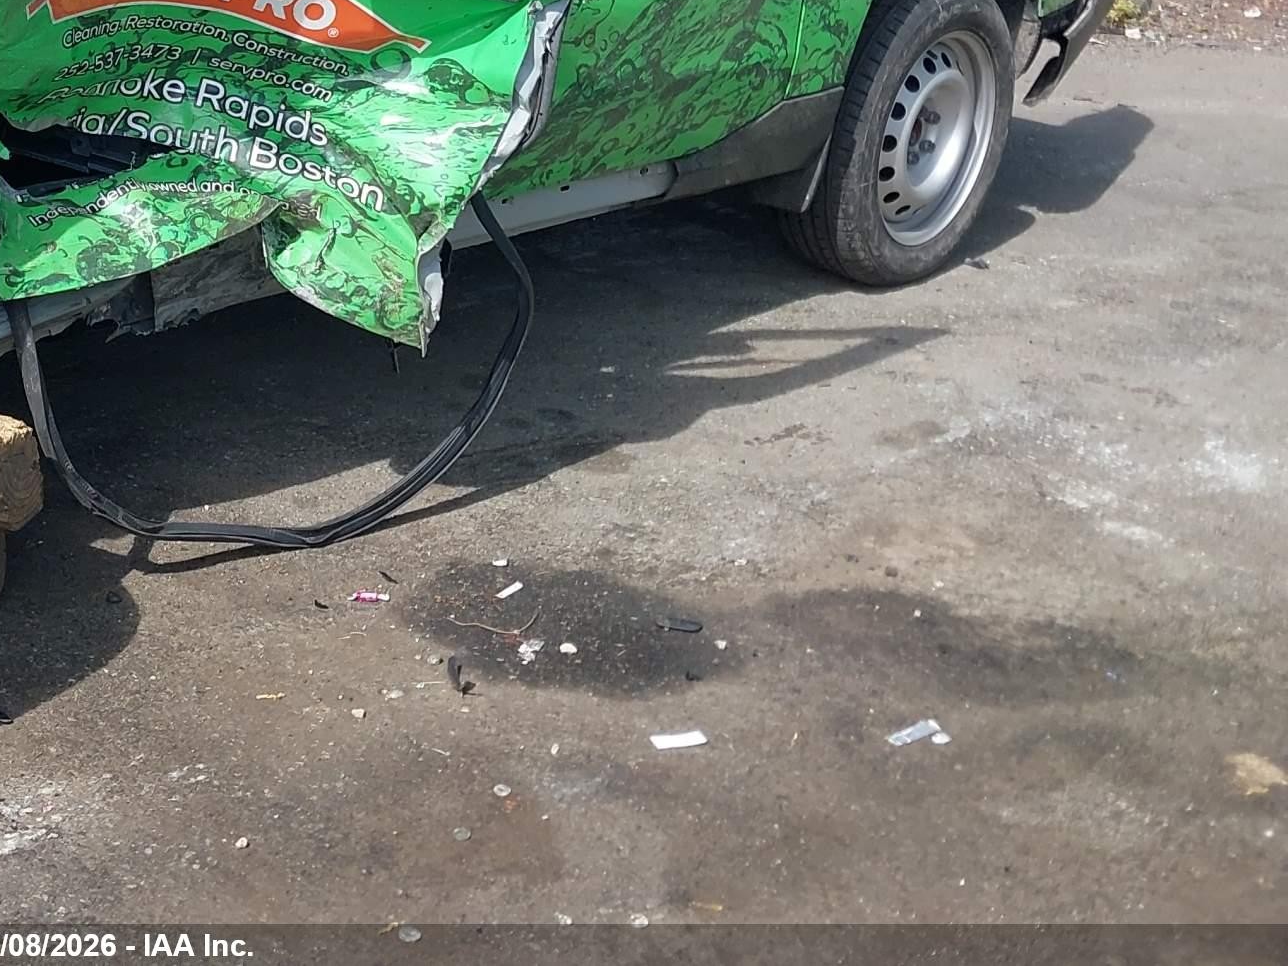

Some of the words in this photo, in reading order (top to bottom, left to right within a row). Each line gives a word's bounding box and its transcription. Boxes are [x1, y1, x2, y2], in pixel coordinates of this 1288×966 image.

[54, 44, 182, 81] 252-537-3473
[208, 57, 333, 102] servpro.com
[62, 19, 122, 48] Cleaning.
[125, 15, 229, 42] Restoration.
[232, 32, 350, 76] Construction.
[195, 78, 328, 146] Rapids
[148, 178, 197, 193] owned
[201, 182, 234, 193] and
[248, 136, 384, 212] Boston
